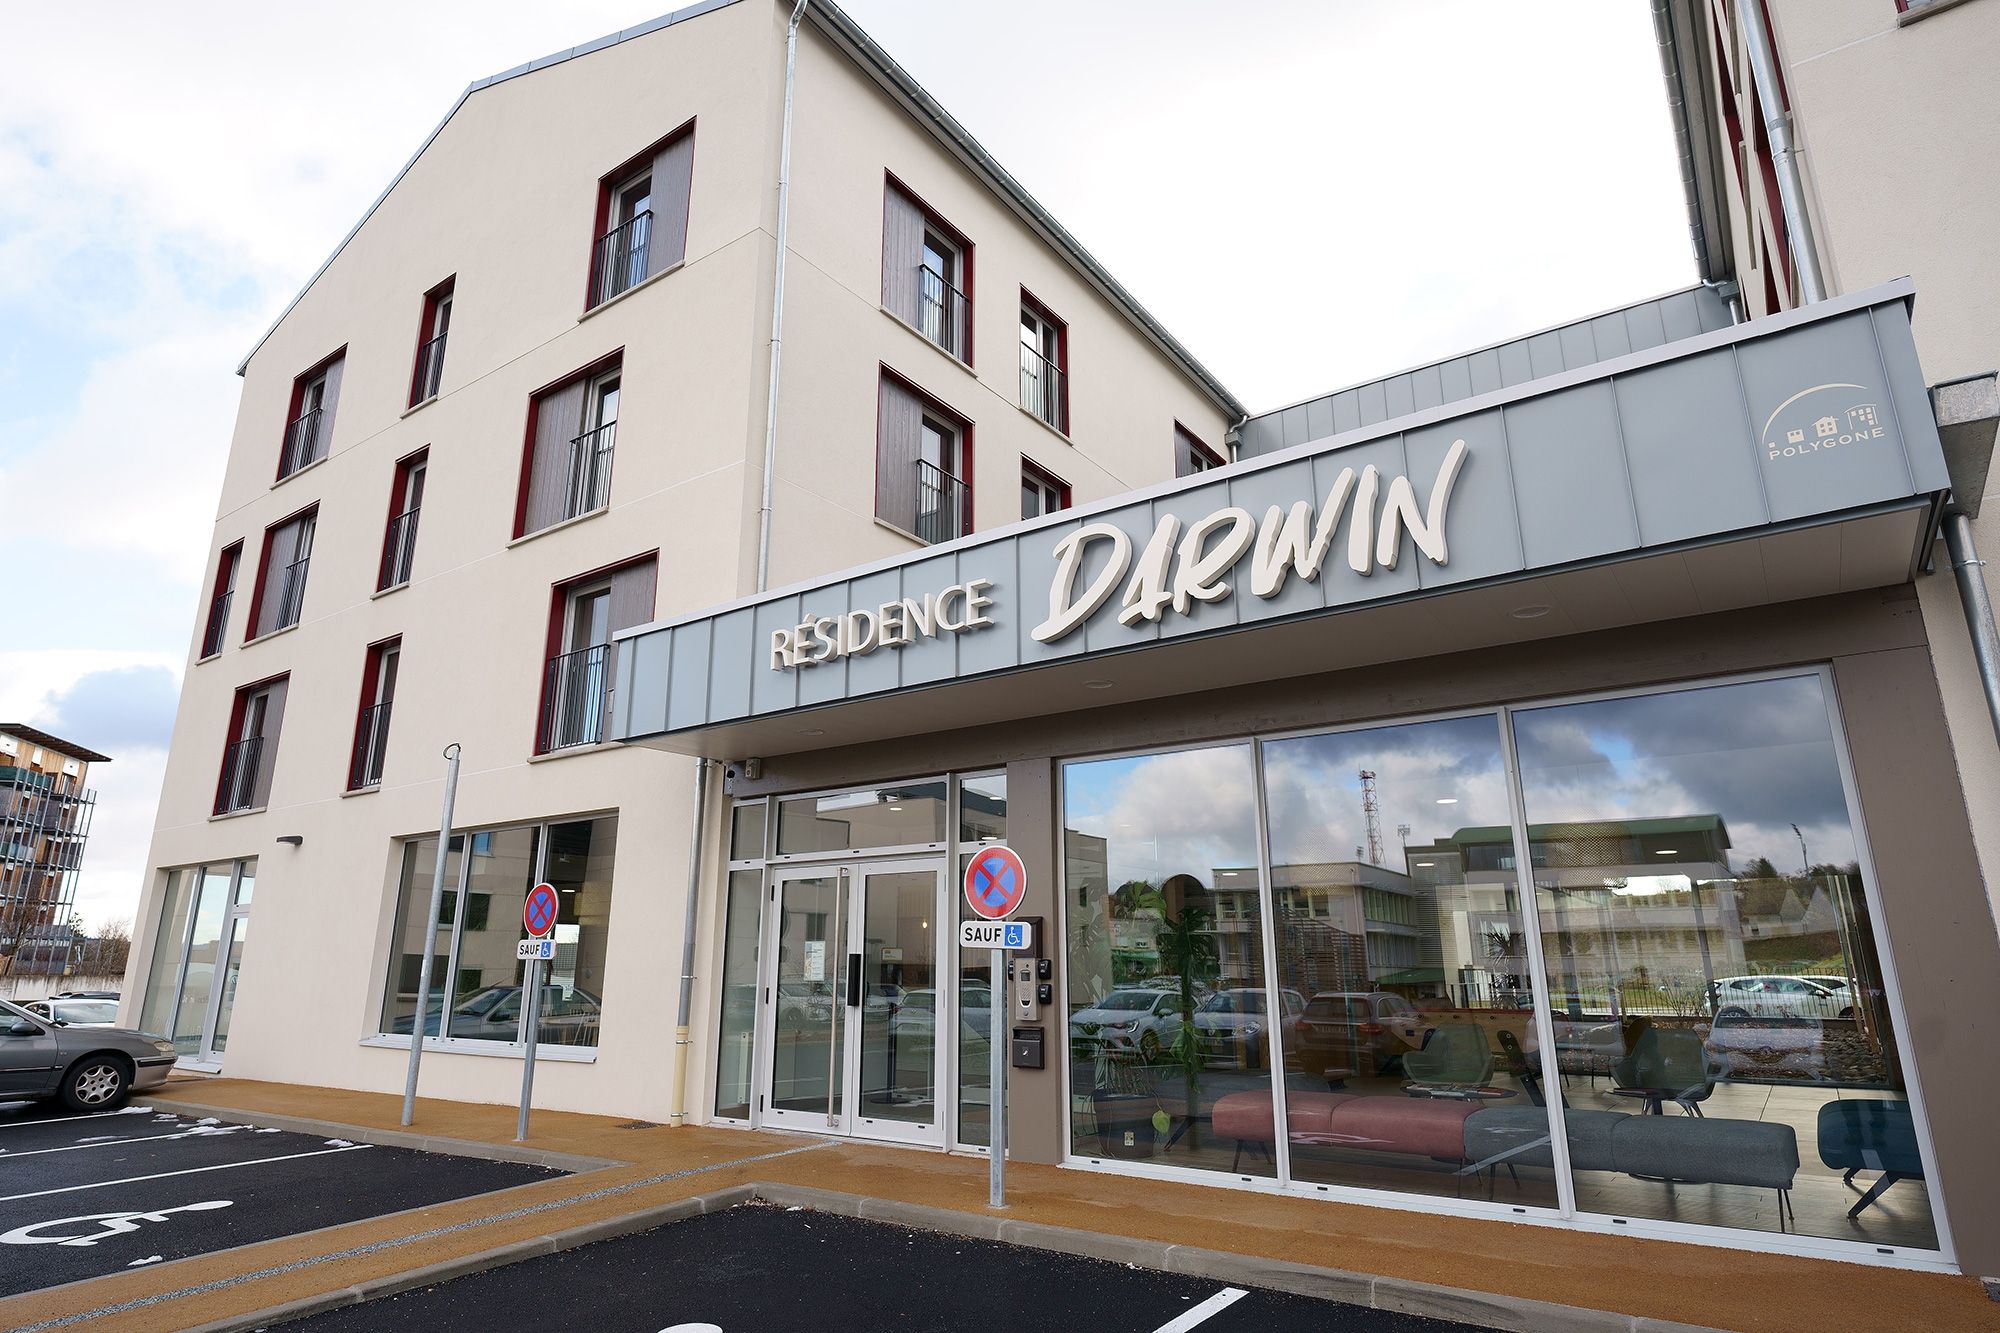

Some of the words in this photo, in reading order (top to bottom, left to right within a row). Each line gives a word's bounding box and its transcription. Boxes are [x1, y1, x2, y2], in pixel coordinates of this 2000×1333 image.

[1769, 427, 1885, 460] POLYGONE
[770, 577, 994, 671] RÉSIDENCE
[1031, 439, 1470, 644] DARWIN
[964, 927, 1002, 942] SAUF
[519, 944, 540, 955] SAUF
